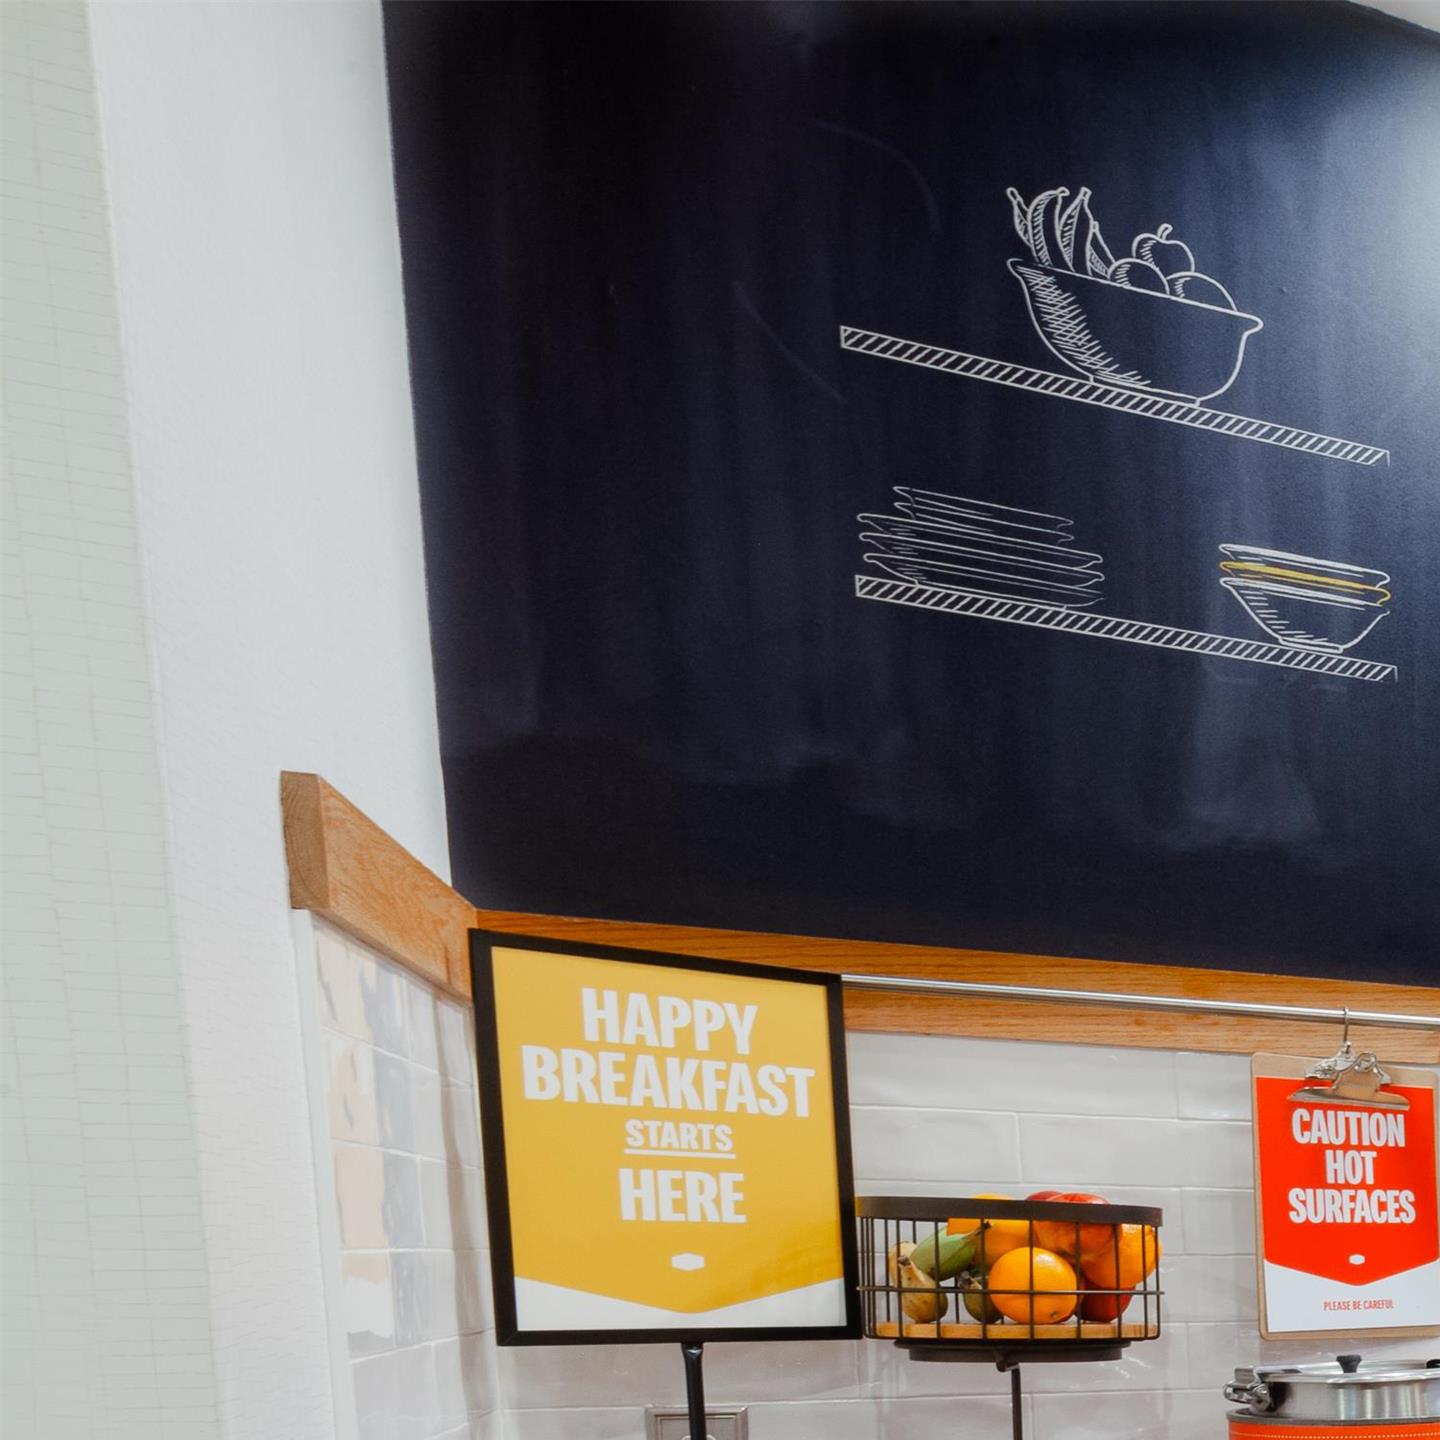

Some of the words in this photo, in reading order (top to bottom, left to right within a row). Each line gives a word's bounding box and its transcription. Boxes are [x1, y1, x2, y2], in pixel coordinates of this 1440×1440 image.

[581, 987, 758, 1055] HAPPY
[521, 1045, 815, 1118] BREAKFAST
[625, 1119, 733, 1151] STARTS
[1292, 1108, 1405, 1147] CAUTION
[1325, 1149, 1377, 1185] HOT
[619, 1168, 747, 1223] HERE
[1288, 1187, 1416, 1224] SURFACES
[1323, 1300, 1351, 1311] PLEASE
[1352, 1300, 1362, 1310] BE
[1363, 1298, 1394, 1309] CAREFUL
